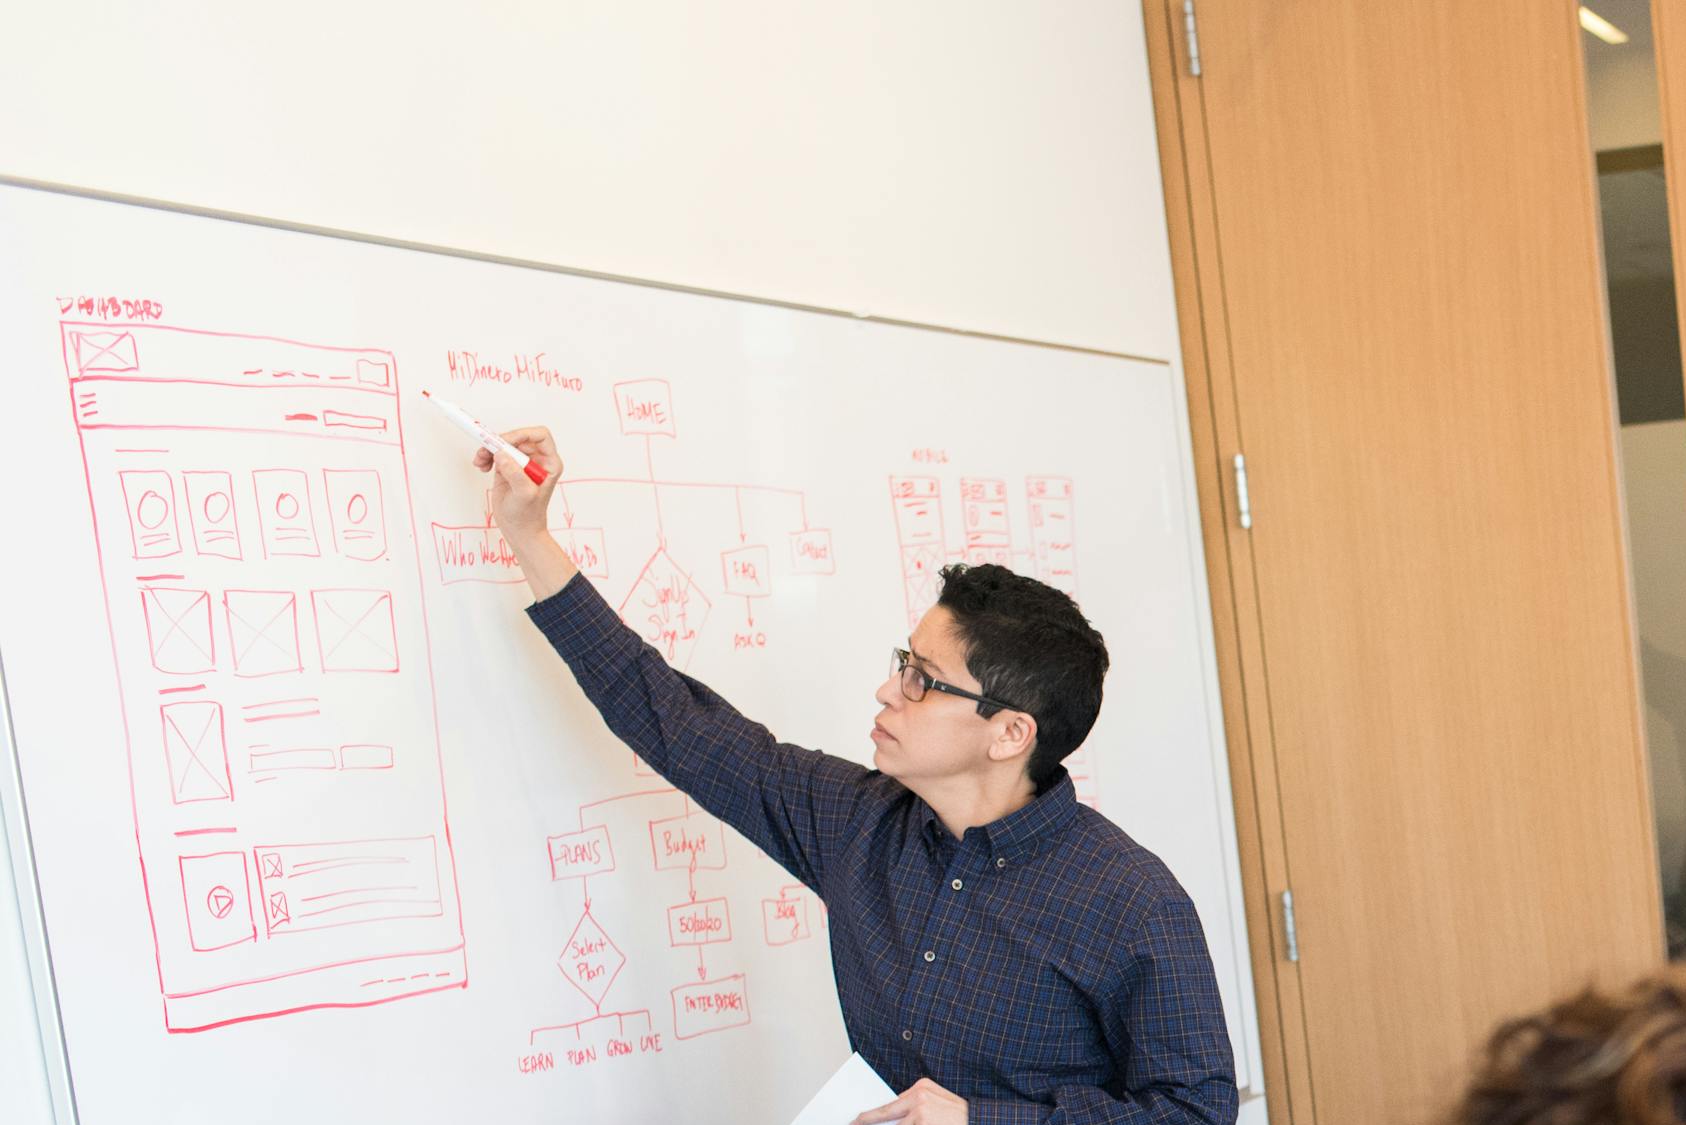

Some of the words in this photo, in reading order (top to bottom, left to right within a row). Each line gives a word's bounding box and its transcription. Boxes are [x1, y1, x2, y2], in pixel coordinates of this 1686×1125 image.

[442, 532, 476, 567] Who
[663, 828, 706, 872] Budget
[576, 962, 606, 982] Plan
[518, 1052, 554, 1074] LEARN
[567, 1046, 597, 1066] PLAN
[607, 1038, 633, 1057] GROW
